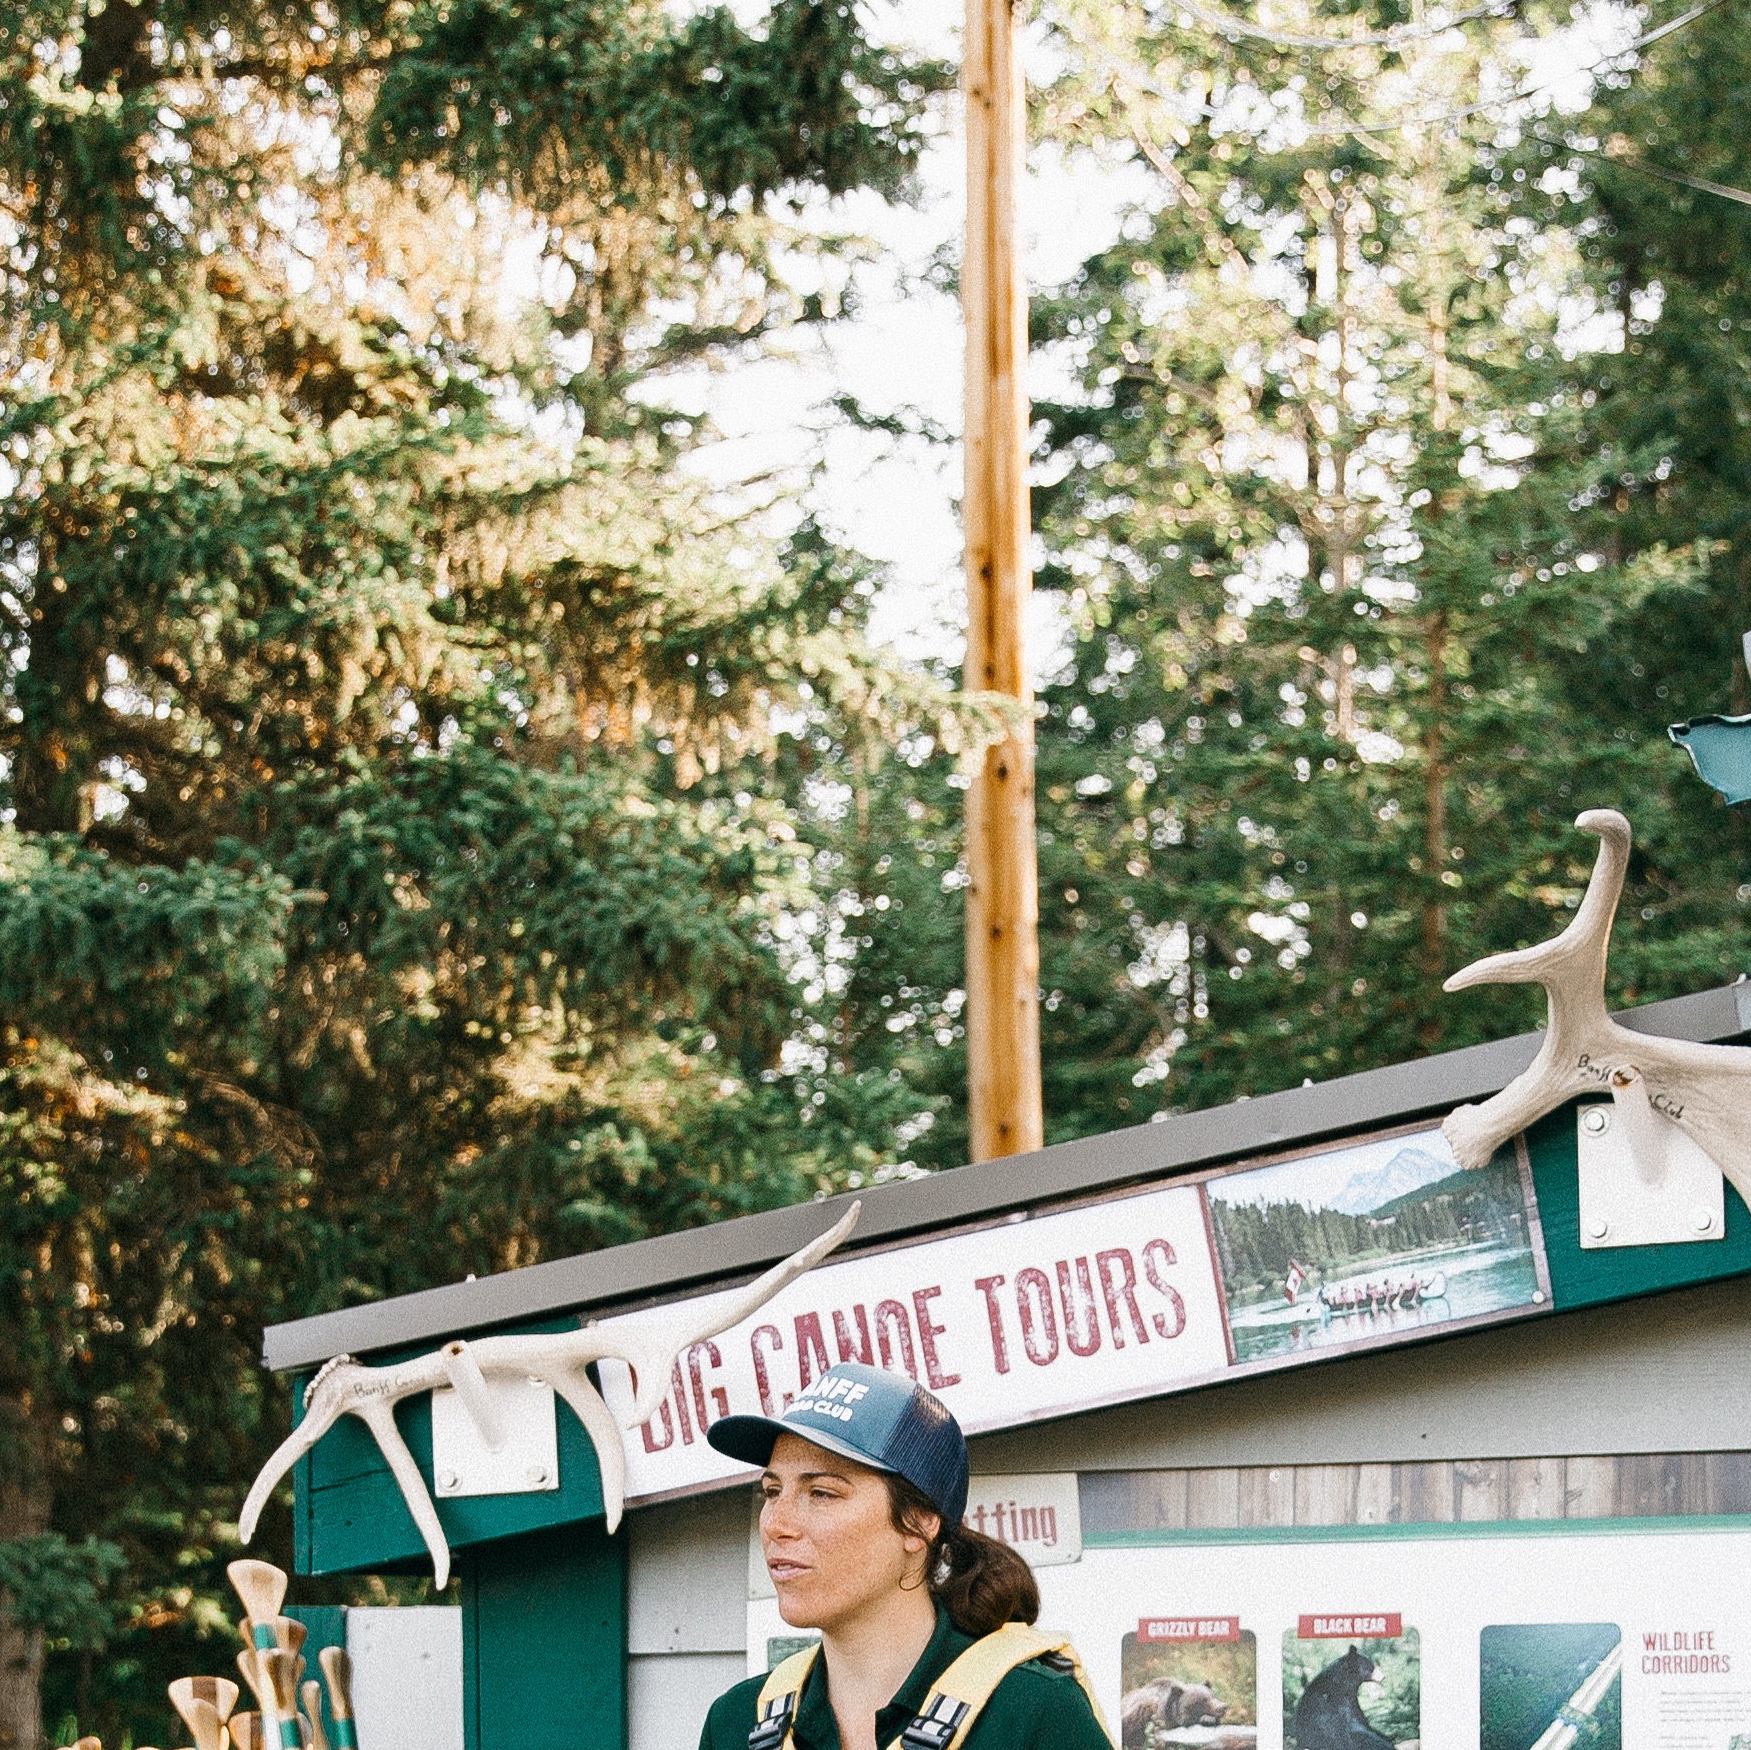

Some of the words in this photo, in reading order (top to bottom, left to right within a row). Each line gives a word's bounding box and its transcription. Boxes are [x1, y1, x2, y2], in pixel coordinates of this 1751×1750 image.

[751, 1286, 961, 1418] CANOE
[975, 1239, 1186, 1375] TOURS
[962, 1501, 1057, 1547] tting
[1147, 1621, 1196, 1637] GRIZZLY
[1197, 1620, 1230, 1636] BEAR
[1313, 1618, 1353, 1634] BLACK
[1353, 1617, 1387, 1633] BEAR
[1642, 1631, 1715, 1651] WILDLIFE
[1642, 1654, 1730, 1674] CORRIDORS
